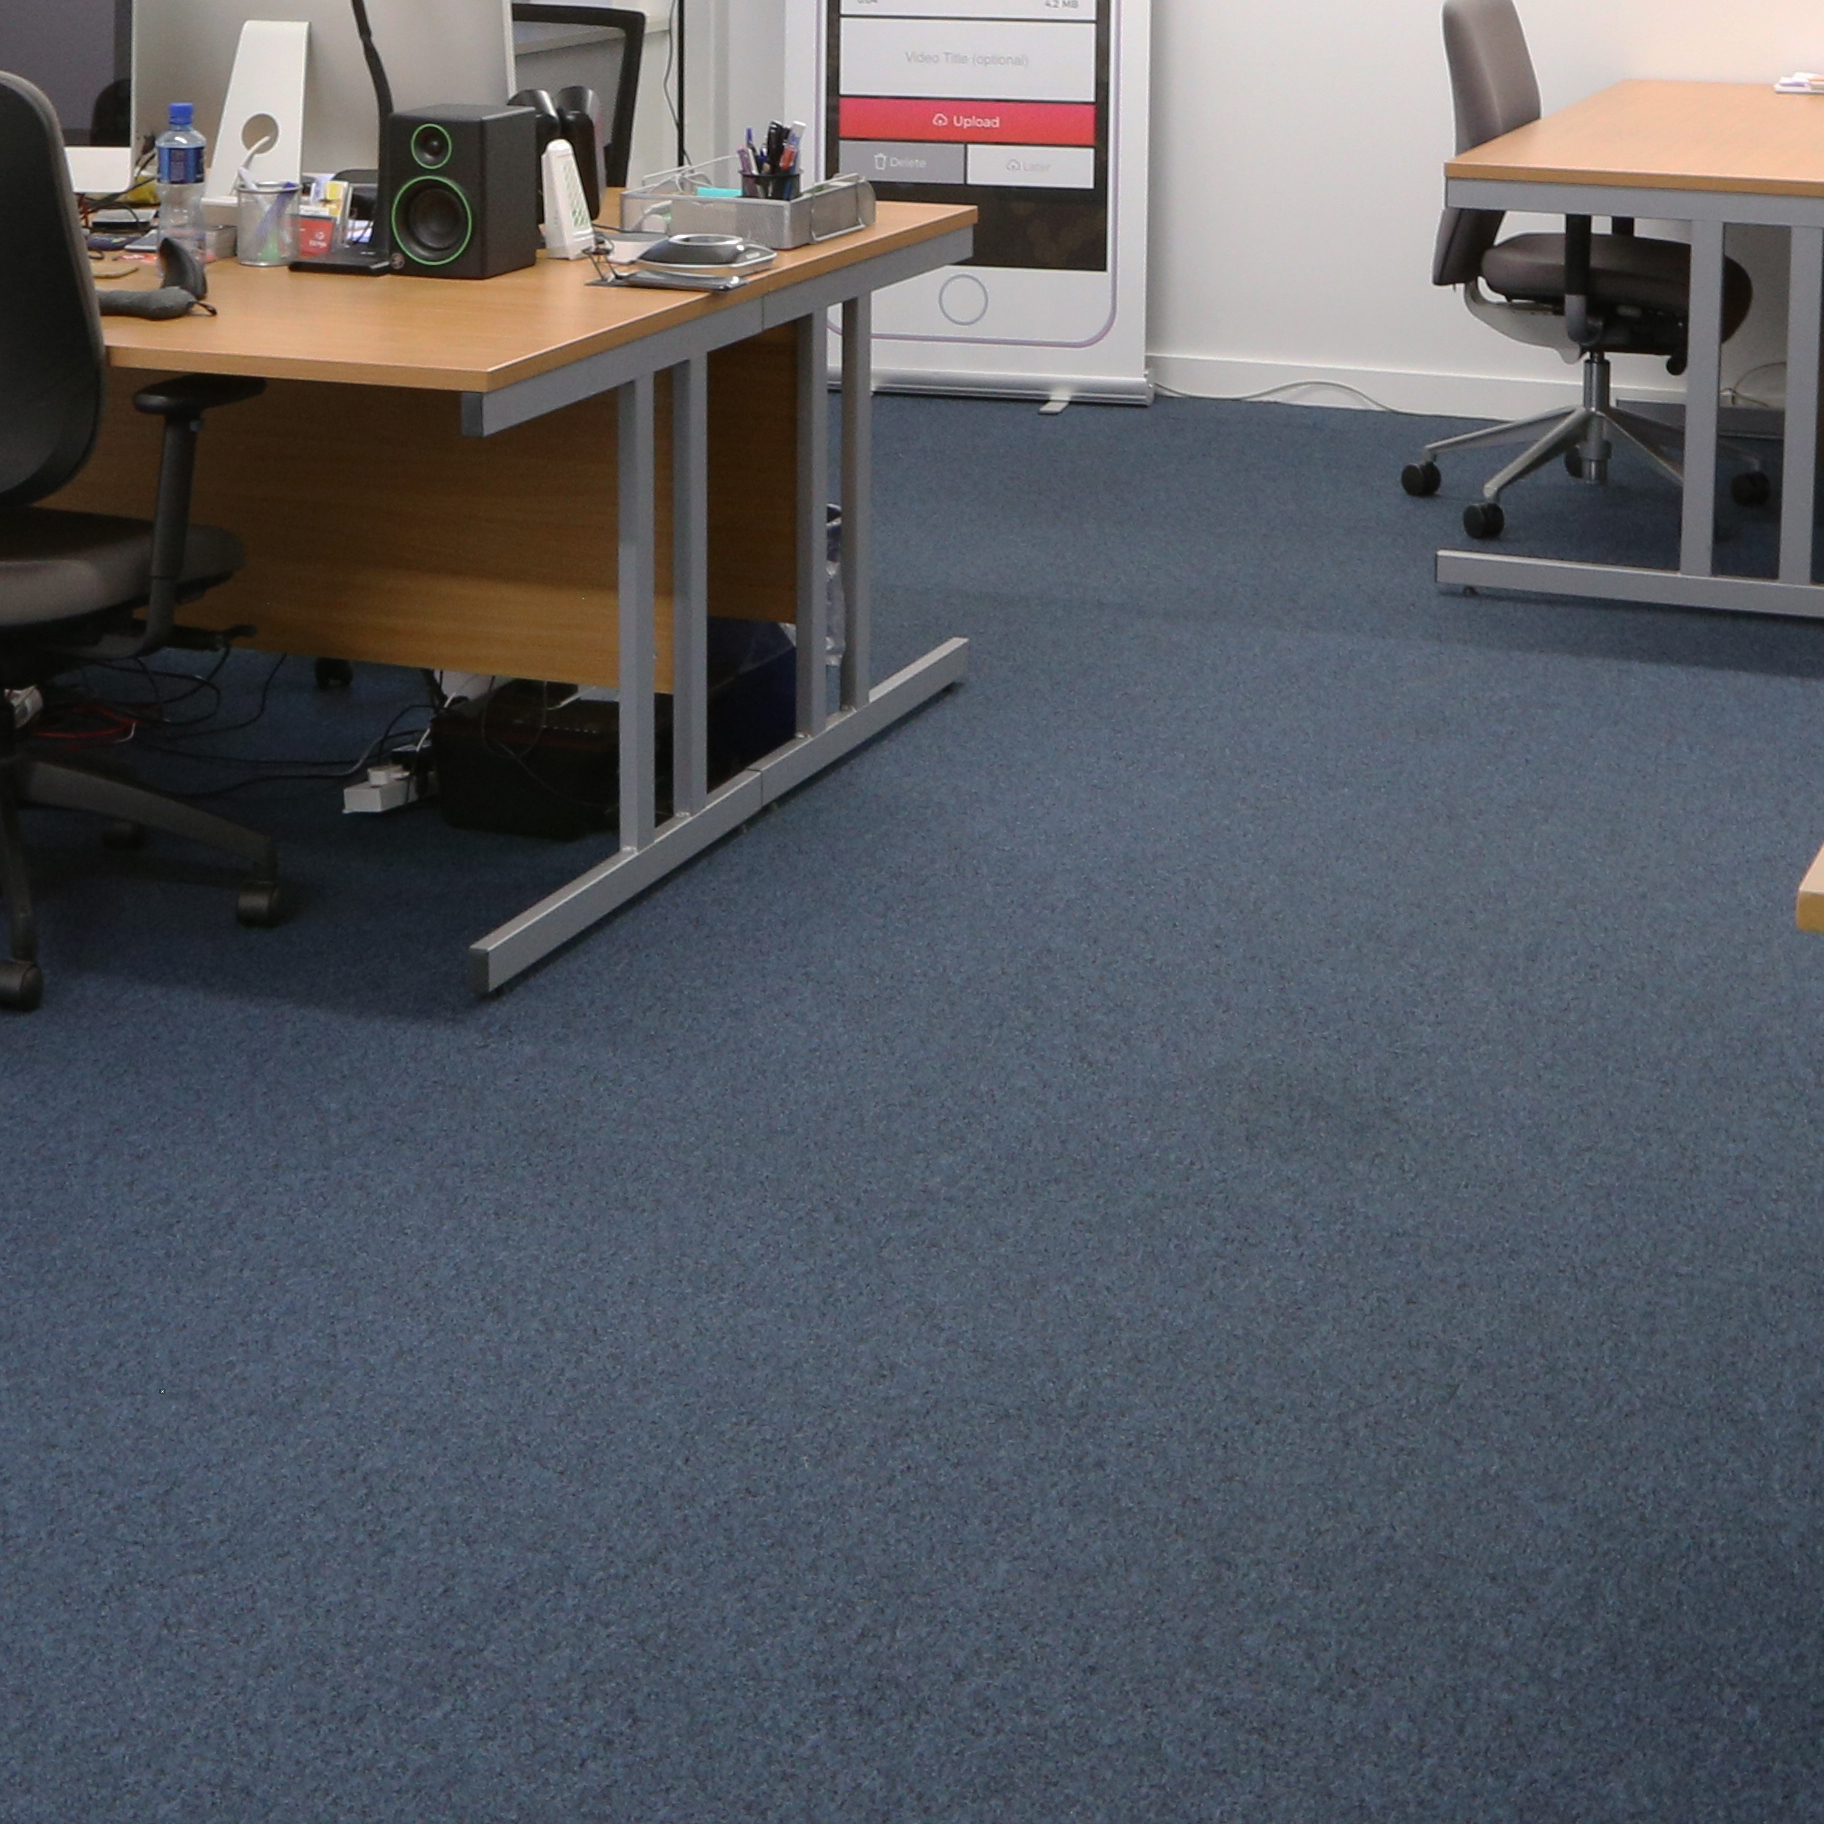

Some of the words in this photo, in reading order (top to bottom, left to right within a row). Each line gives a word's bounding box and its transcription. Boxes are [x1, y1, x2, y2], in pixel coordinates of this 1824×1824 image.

[1044, 0, 1060, 9] 4.2
[1061, 0, 1080, 9] MB
[905, 50, 940, 65] Video
[943, 51, 969, 65] Title
[972, 52, 1029, 68] (optional)
[952, 115, 1001, 129] Upload
[890, 156, 927, 169] Delete
[1022, 160, 1052, 173] Later
